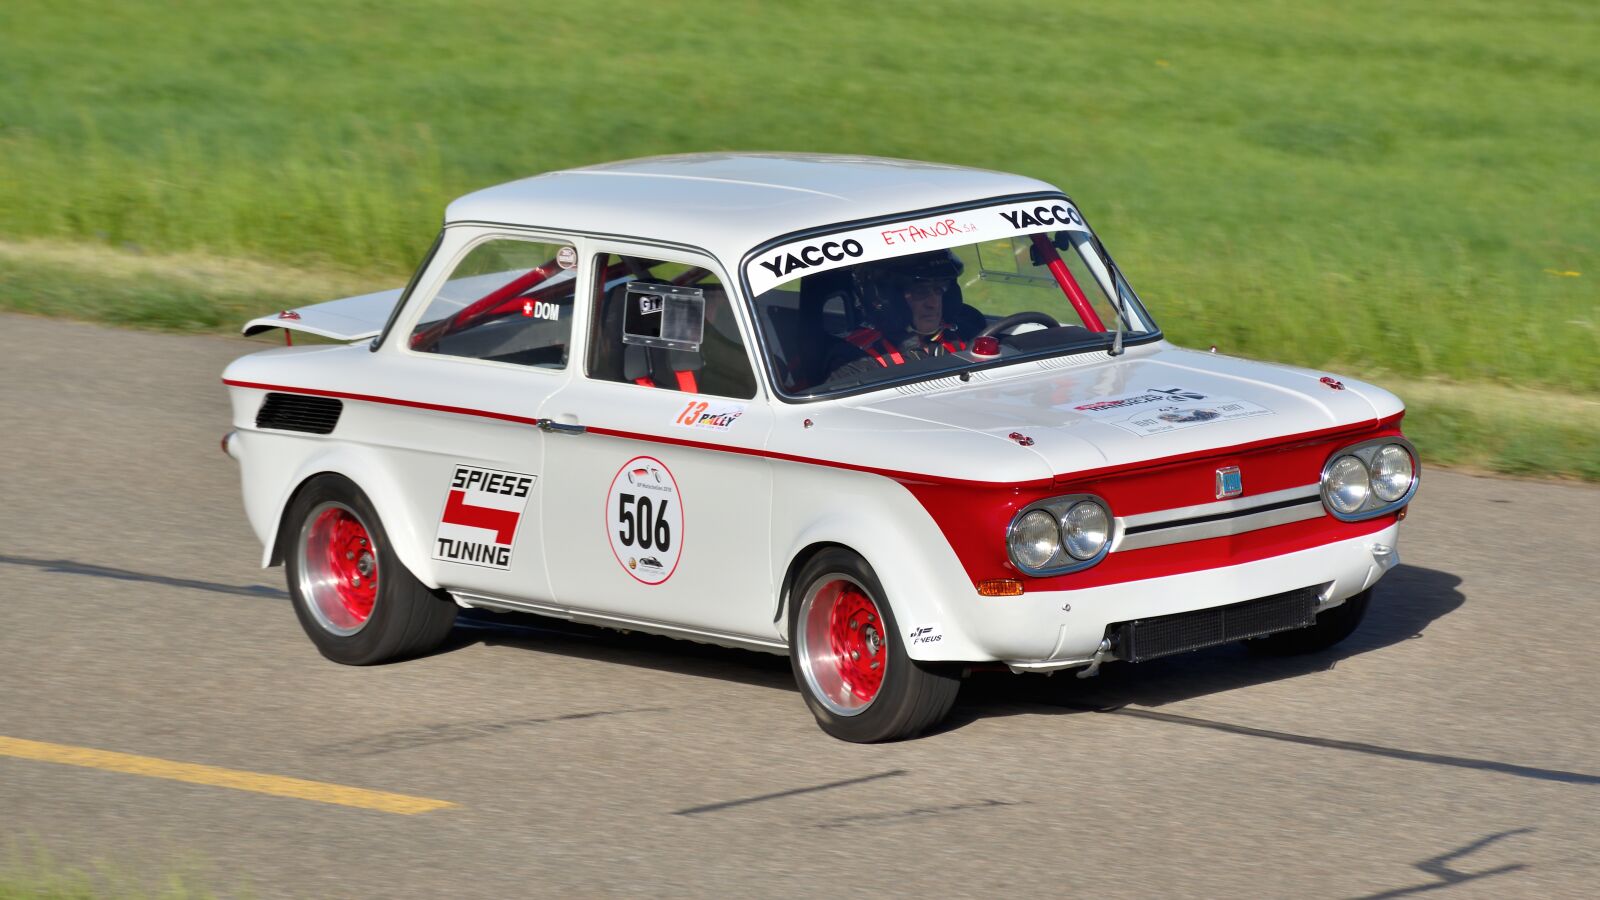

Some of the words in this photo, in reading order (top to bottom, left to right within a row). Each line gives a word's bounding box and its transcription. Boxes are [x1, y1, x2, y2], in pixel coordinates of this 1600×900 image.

[998, 204, 1083, 230] YACCO
[881, 219, 962, 246] ETANOR
[760, 238, 864, 278] YACCO
[534, 301, 560, 320] DOM
[676, 401, 709, 426] 13
[452, 468, 533, 498] SPIESS
[619, 492, 671, 553] 506
[438, 537, 511, 567] TUNING
